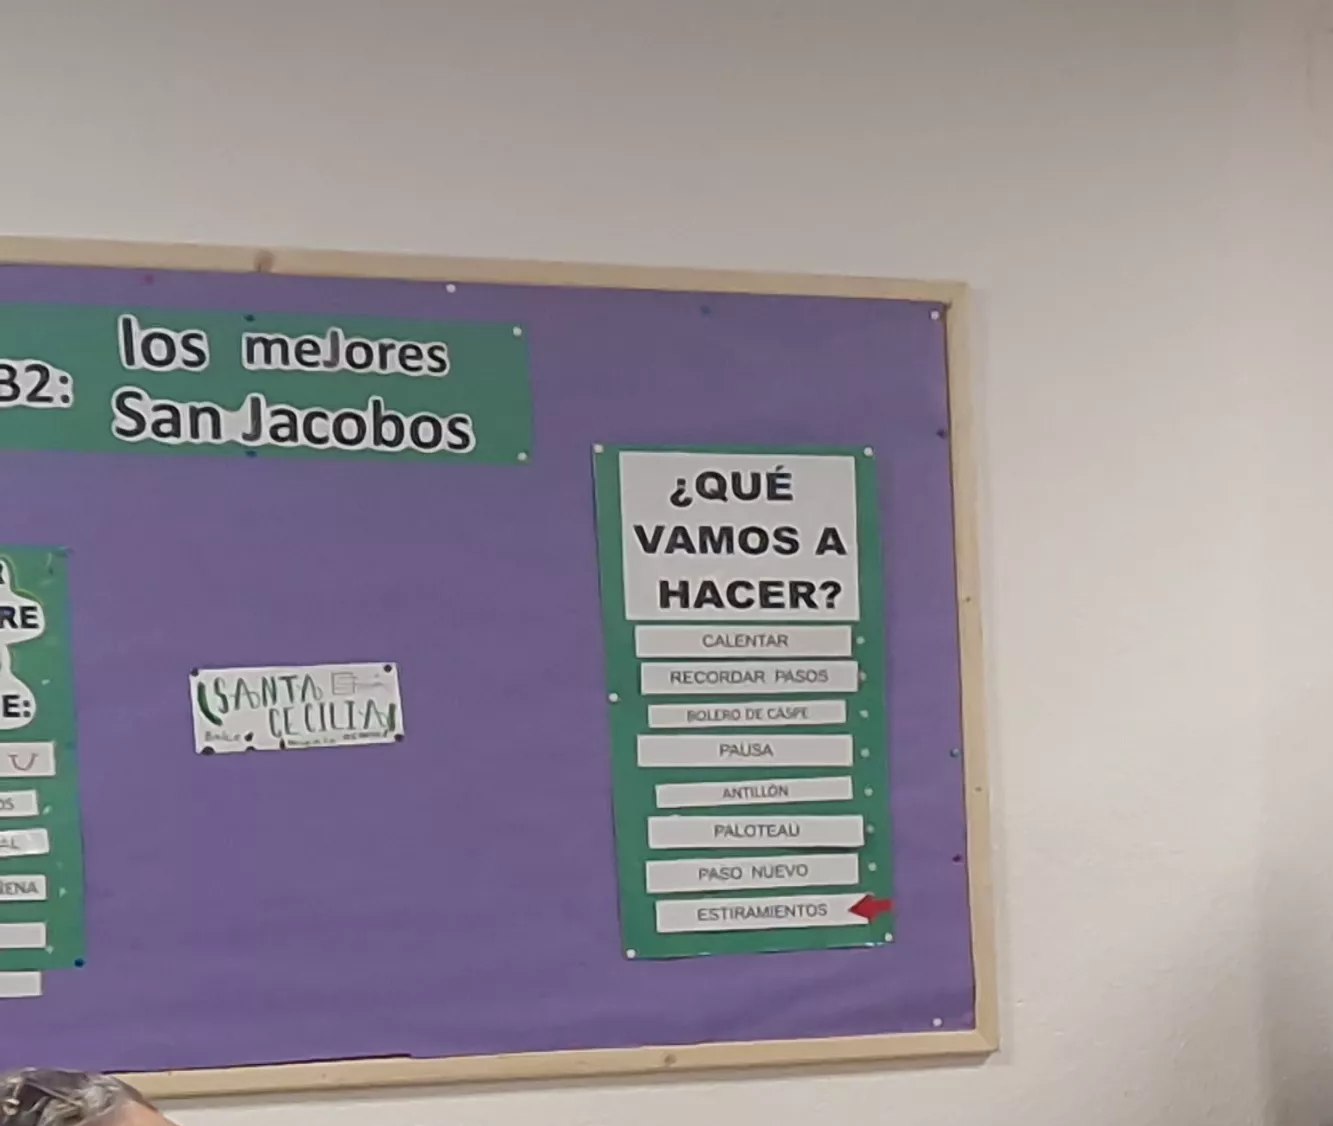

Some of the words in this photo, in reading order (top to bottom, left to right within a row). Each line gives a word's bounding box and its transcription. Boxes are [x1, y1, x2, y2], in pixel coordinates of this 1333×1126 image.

[122, 317, 208, 368] los
[114, 390, 222, 440] San
[241, 396, 472, 450] Jacobos
[669, 465, 794, 507] ¿QUÉ
[632, 524, 801, 555] VAMOS
[814, 527, 848, 555] A
[659, 580, 843, 609] HACER?
[702, 634, 789, 648] CALENTAR
[670, 670, 766, 685] RECORDAR
[775, 668, 829, 684] PASOS
[214, 674, 323, 714] SANTA
[268, 699, 391, 738] CECILIA
[687, 708, 741, 722] BOLERO
[745, 707, 764, 721] DE
[767, 706, 810, 720] CASPE
[719, 743, 774, 758] PAUSA
[714, 823, 801, 838] PALOTEAU
[699, 866, 743, 881] PASO
[751, 863, 809, 879] NUEVO
[697, 903, 828, 922] ESTIRAMIENTOS
